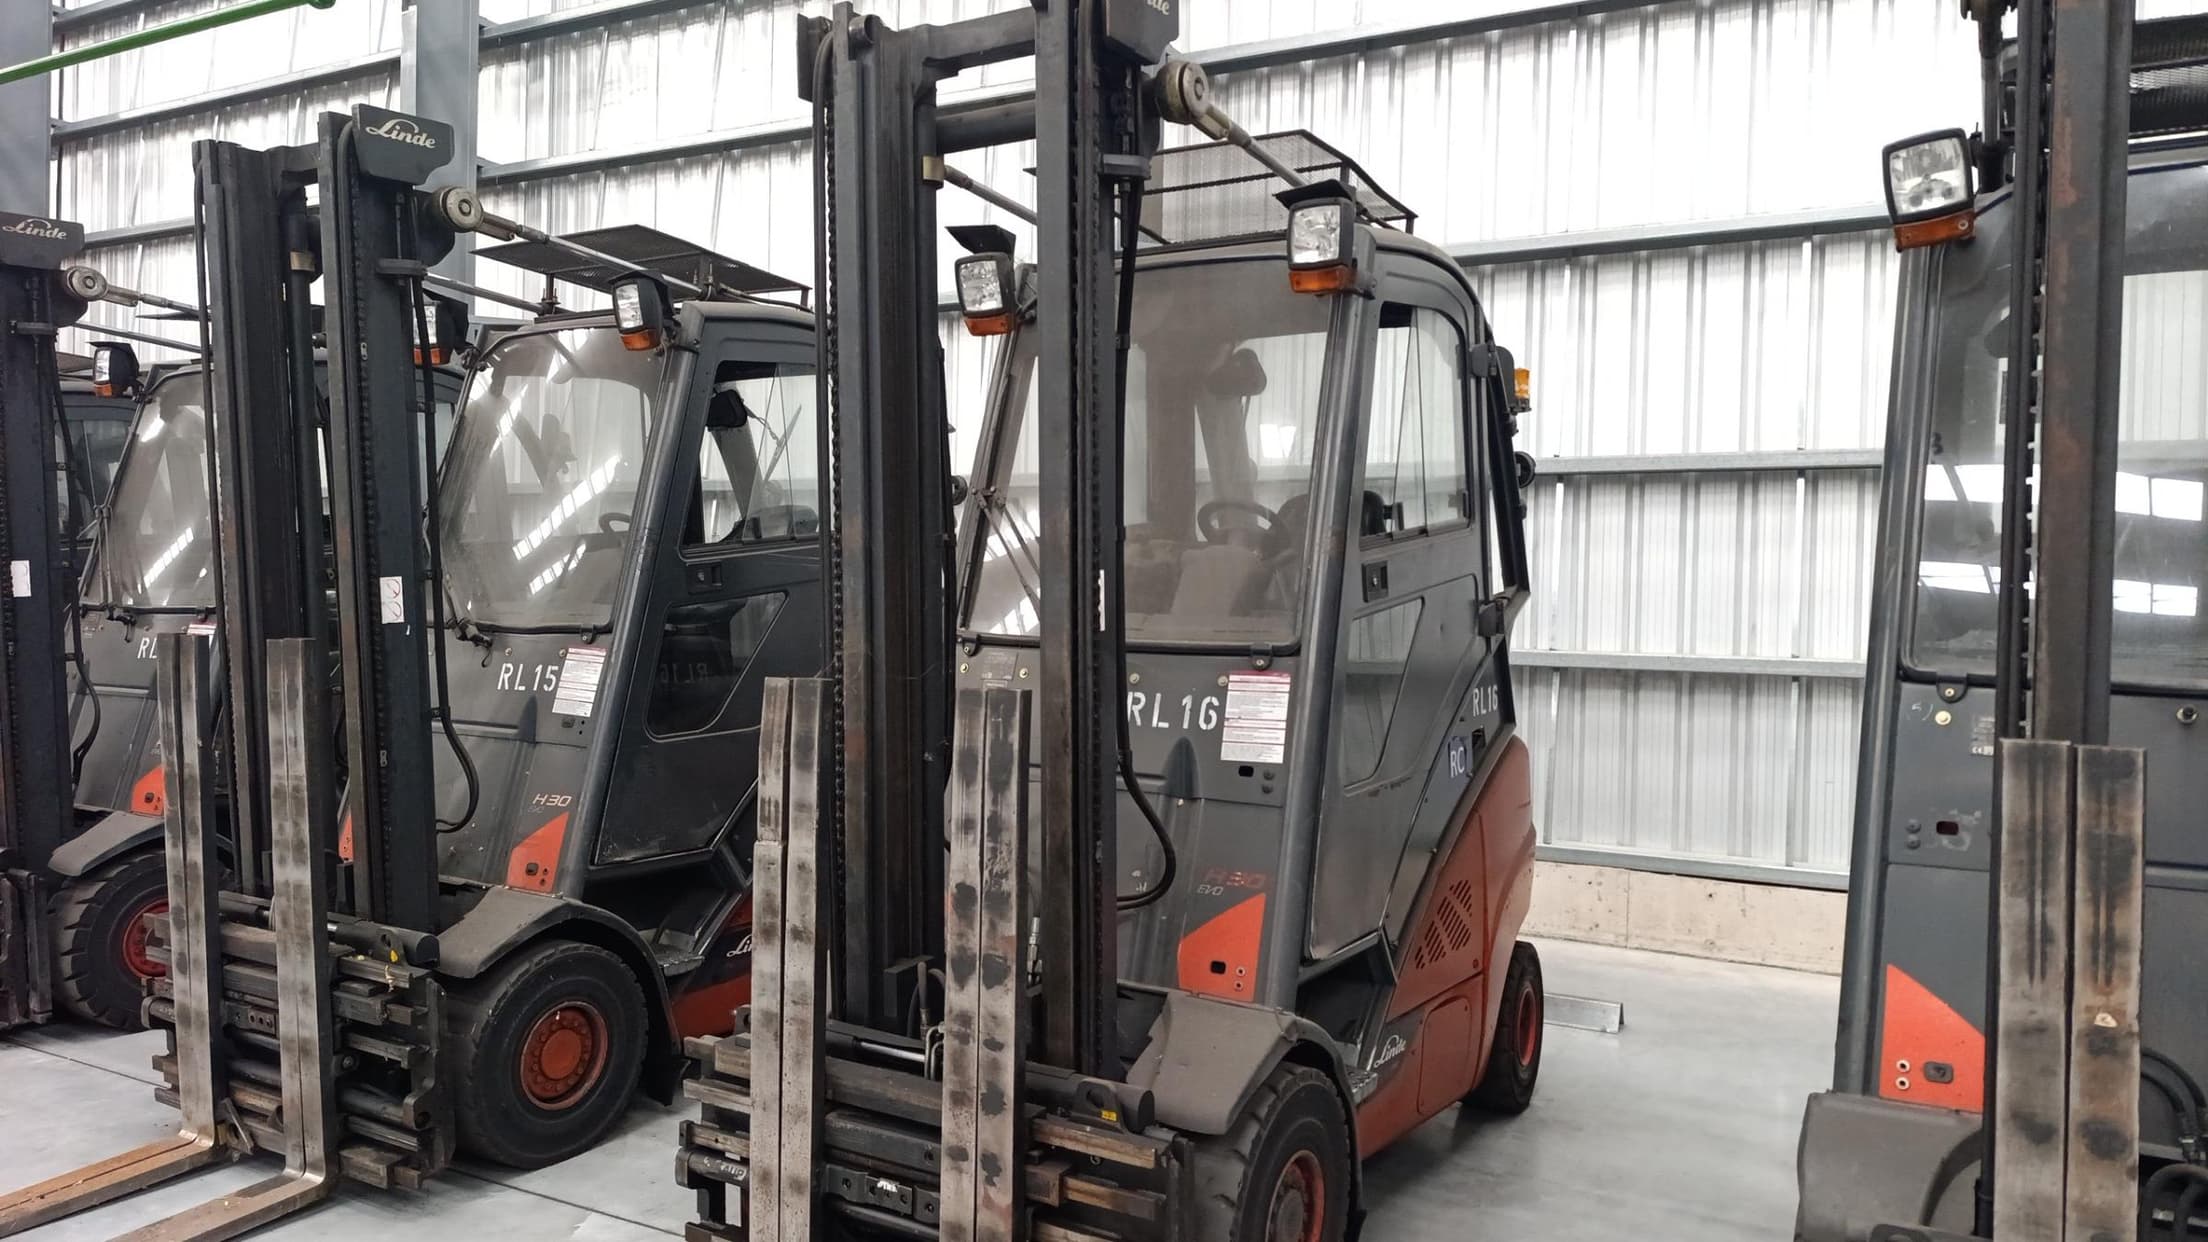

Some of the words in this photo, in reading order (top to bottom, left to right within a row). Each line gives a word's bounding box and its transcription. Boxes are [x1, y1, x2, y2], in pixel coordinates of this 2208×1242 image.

[365, 118, 437, 149] Linde
[2, 218, 68, 240] Linde
[532, 793, 573, 807] H30
